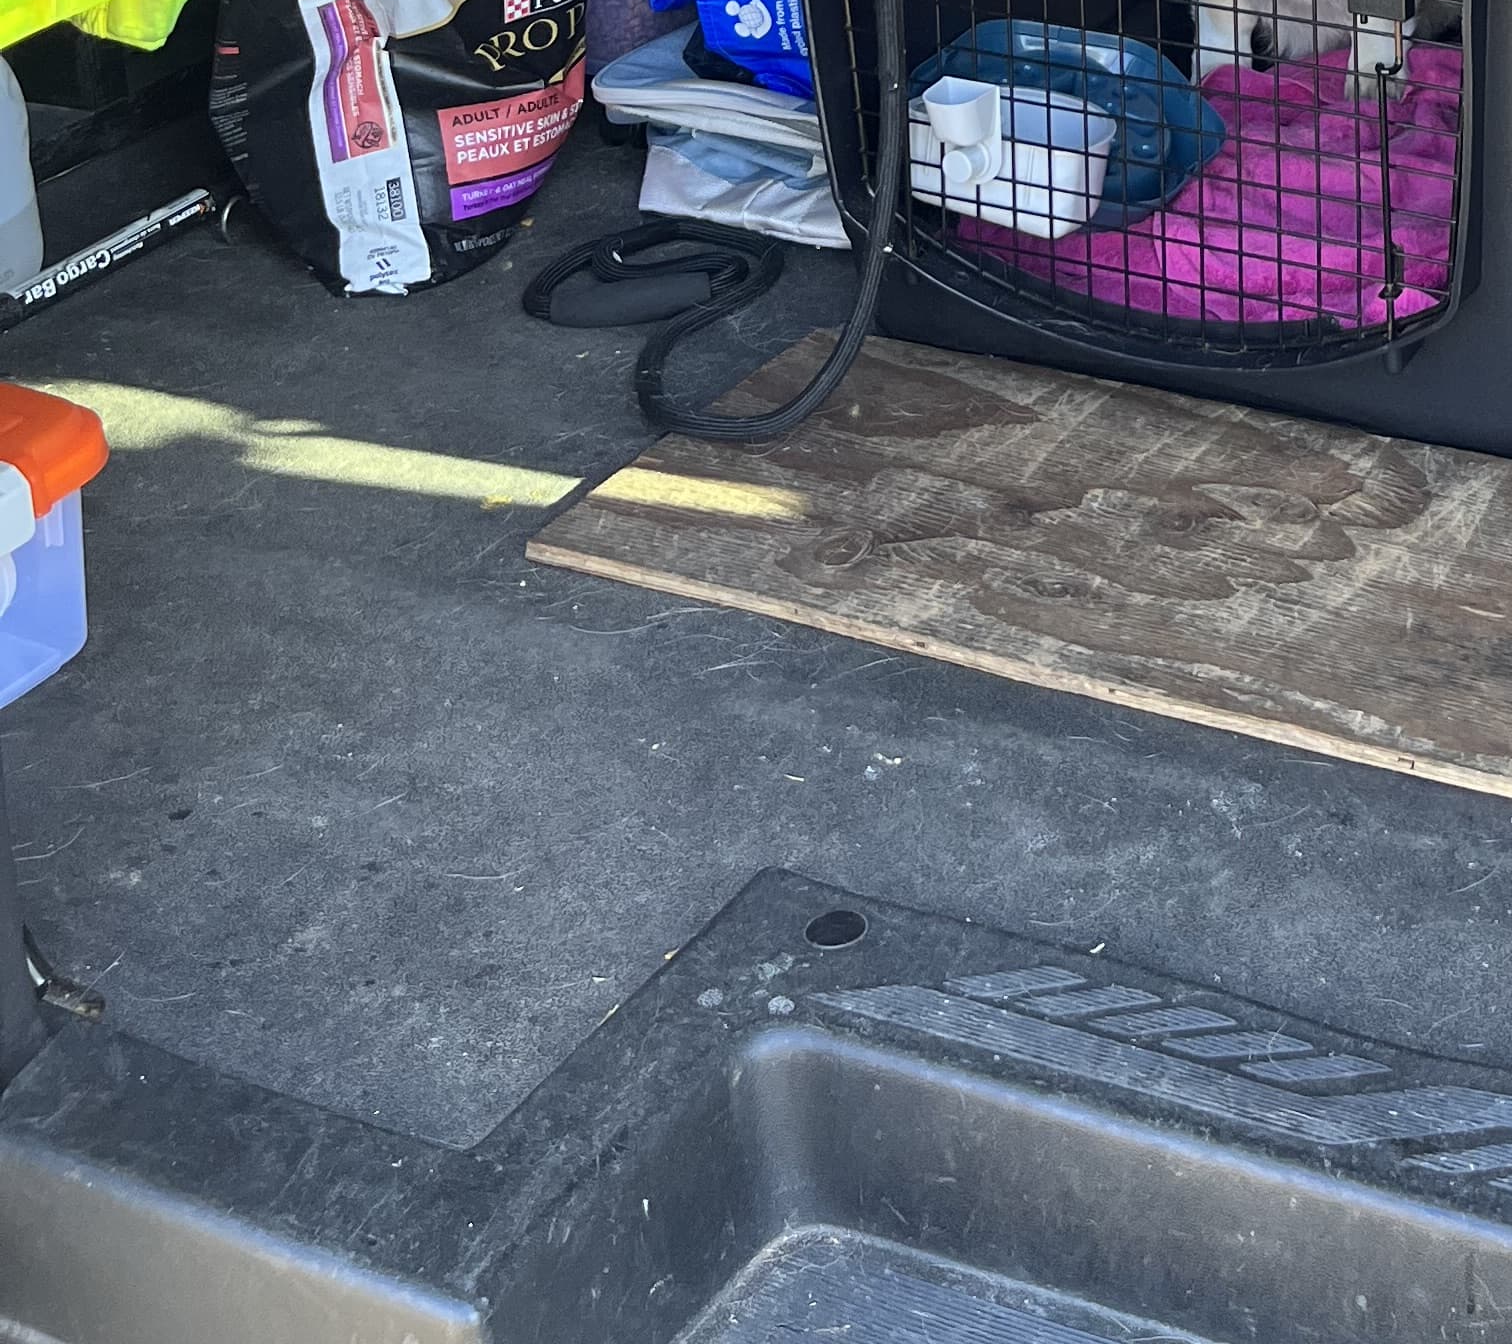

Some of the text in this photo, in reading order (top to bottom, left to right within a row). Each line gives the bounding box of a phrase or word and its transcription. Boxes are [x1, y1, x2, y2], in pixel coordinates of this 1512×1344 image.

[775, 0, 785, 26] from
[474, 18, 559, 72] PRO
[452, 108, 500, 127] ADULT
[518, 94, 560, 114] ADULTE
[454, 121, 534, 147] SENSITIVE
[537, 112, 560, 130] SKIN
[457, 144, 510, 164] PEAUX
[514, 137, 531, 153] ET
[374, 186, 389, 221] 18132
[388, 181, 404, 219] 38100
[57, 249, 111, 286] Cargo
[24, 278, 57, 305] Bar
